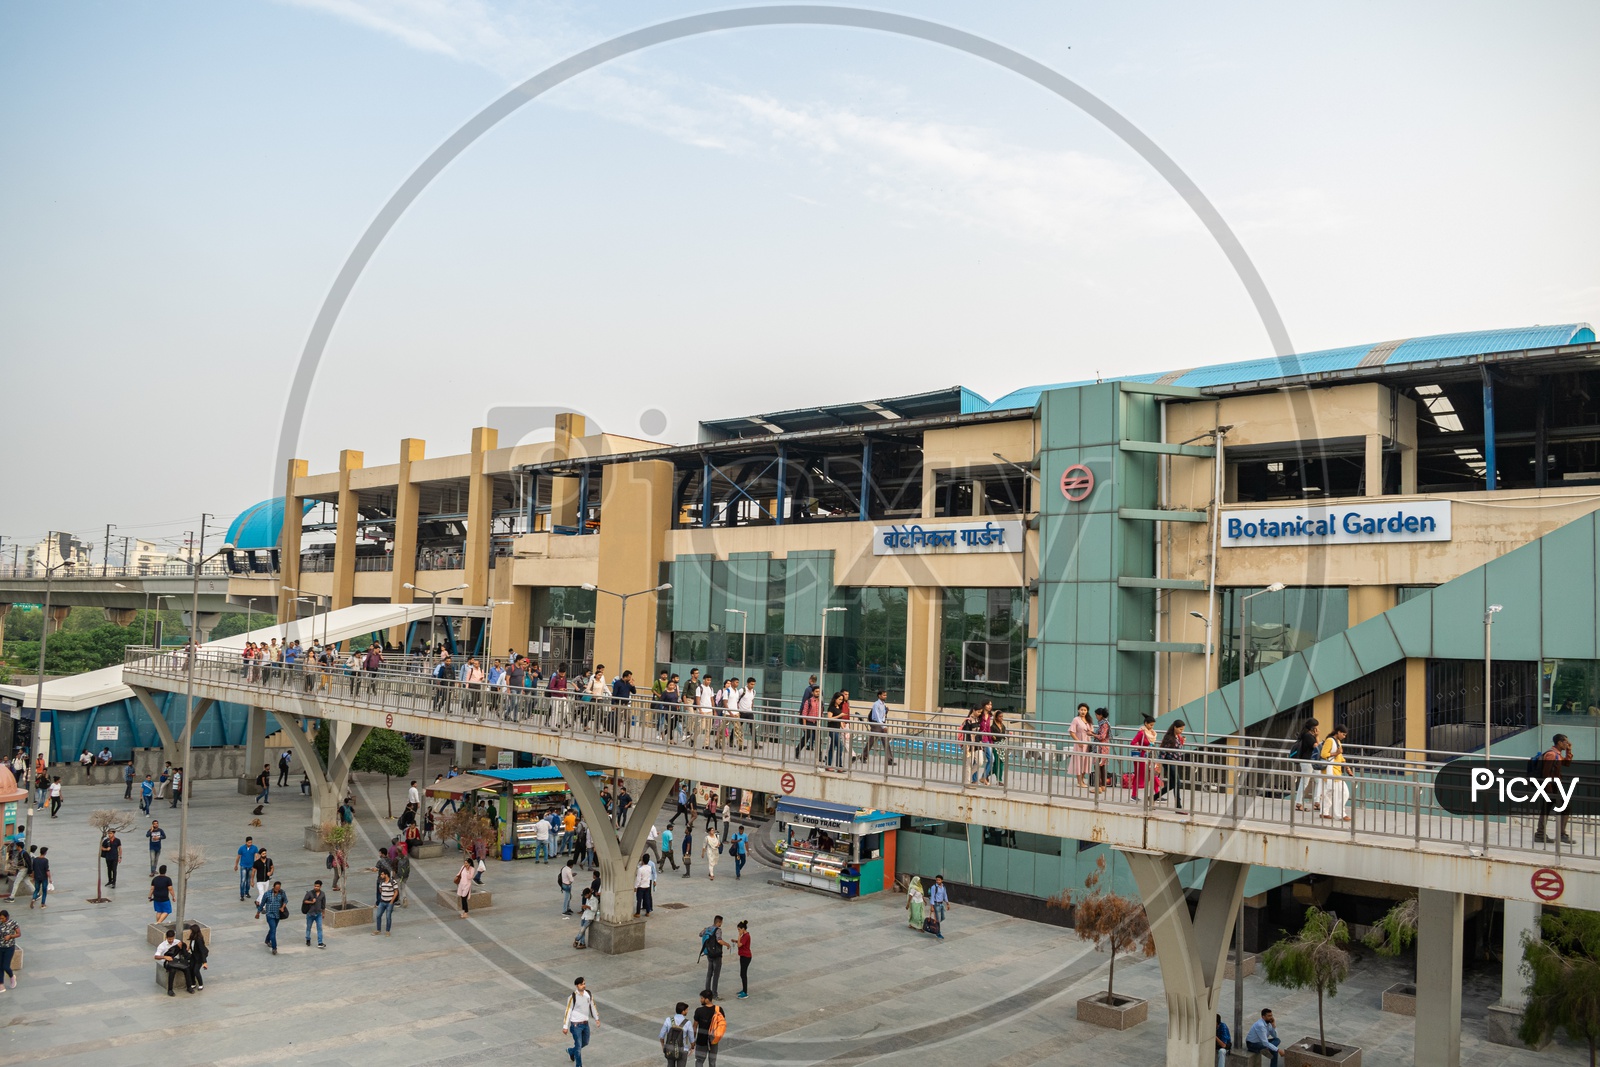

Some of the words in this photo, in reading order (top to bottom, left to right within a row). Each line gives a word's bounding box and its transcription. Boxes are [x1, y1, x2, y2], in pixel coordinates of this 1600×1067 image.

[883, 524, 956, 548] बोटेनिकल
[960, 522, 1005, 546] गार्डन
[1228, 514, 1335, 538] Botanical
[1343, 511, 1436, 534] Garden
[802, 817, 819, 825] FOOD
